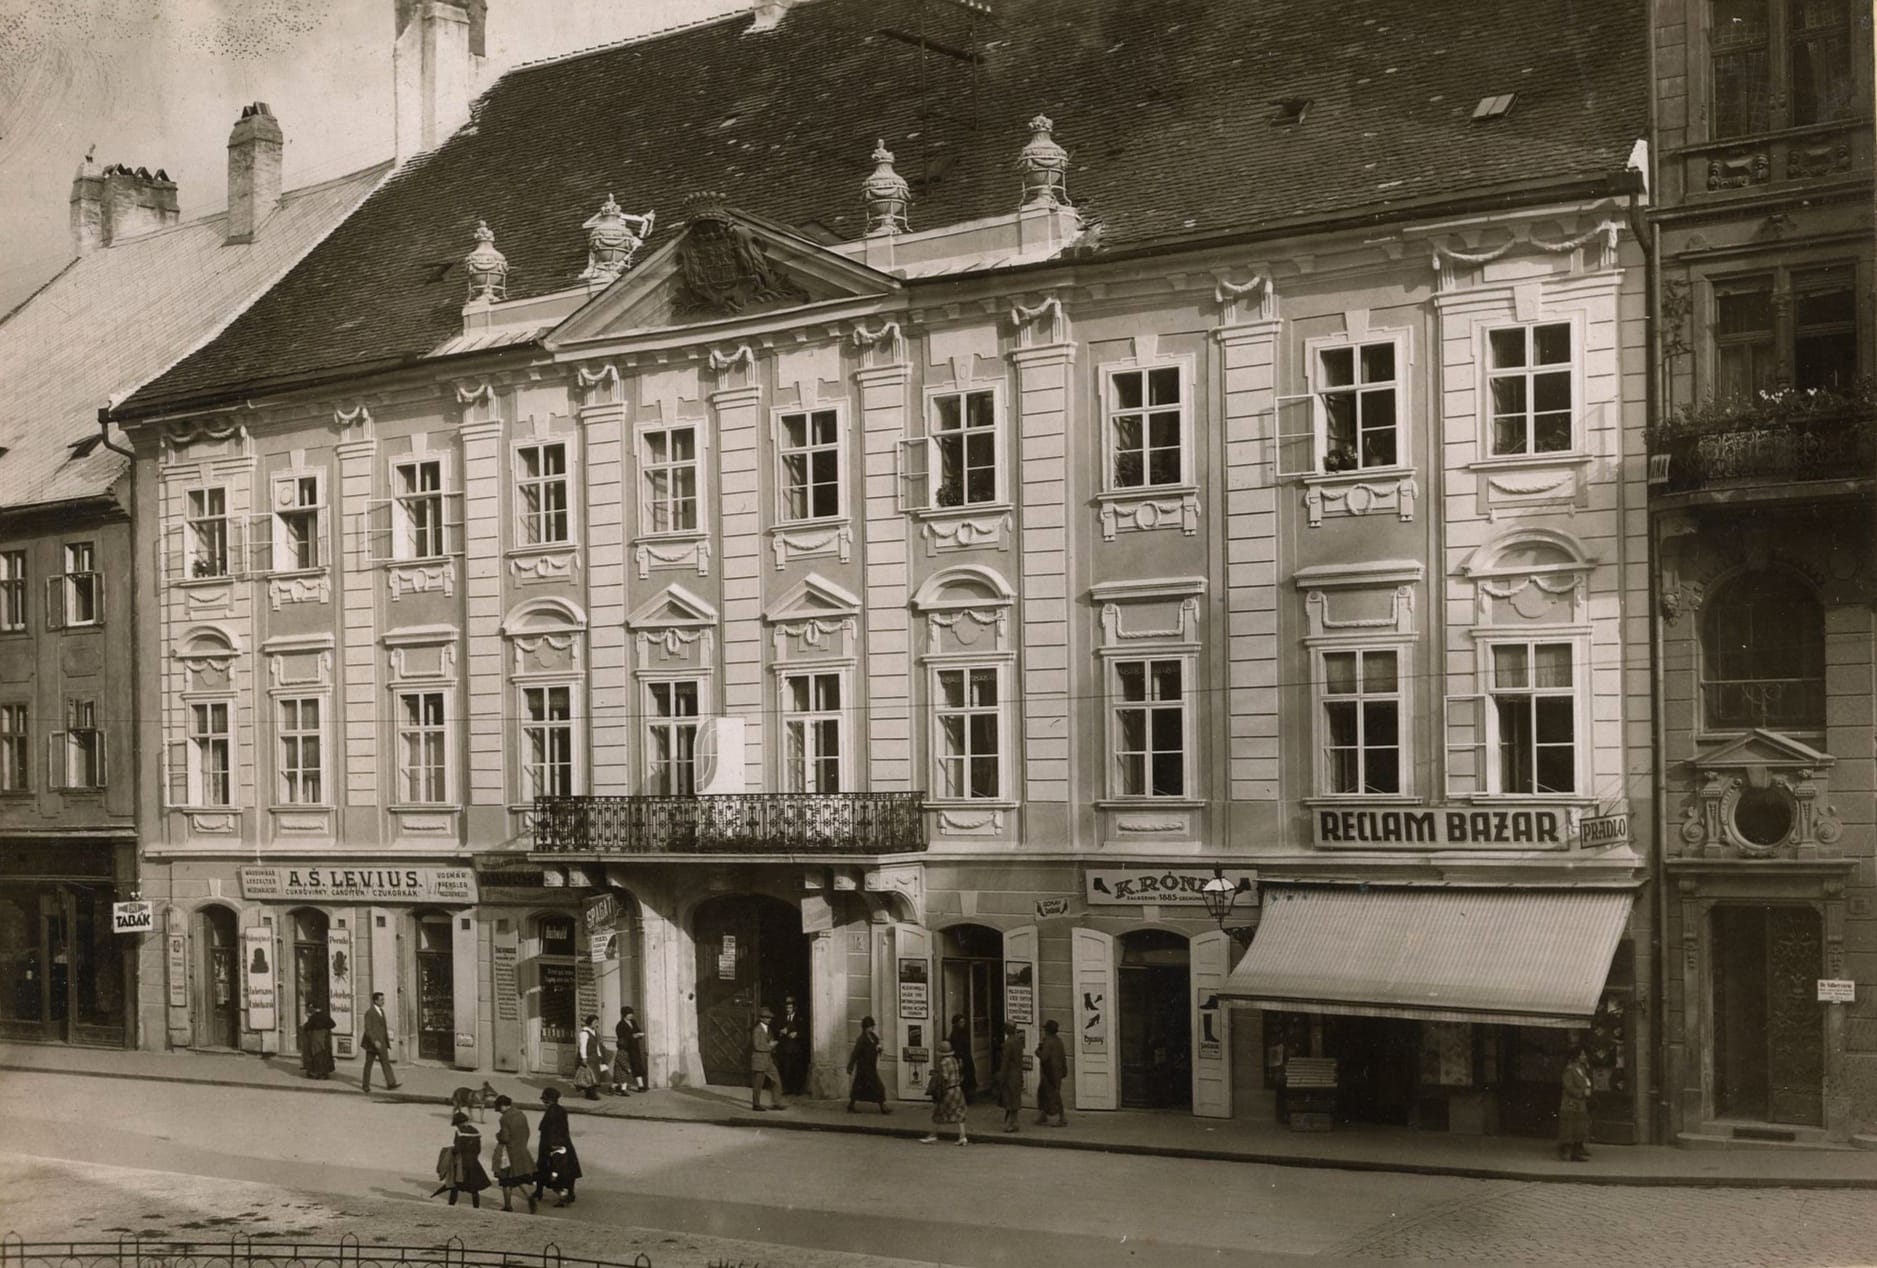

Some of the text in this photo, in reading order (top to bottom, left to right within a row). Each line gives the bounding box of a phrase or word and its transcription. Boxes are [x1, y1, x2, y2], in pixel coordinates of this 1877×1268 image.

[1320, 811, 1559, 843] RECLAM BAZAR
[116, 911, 150, 928] TABÁK
